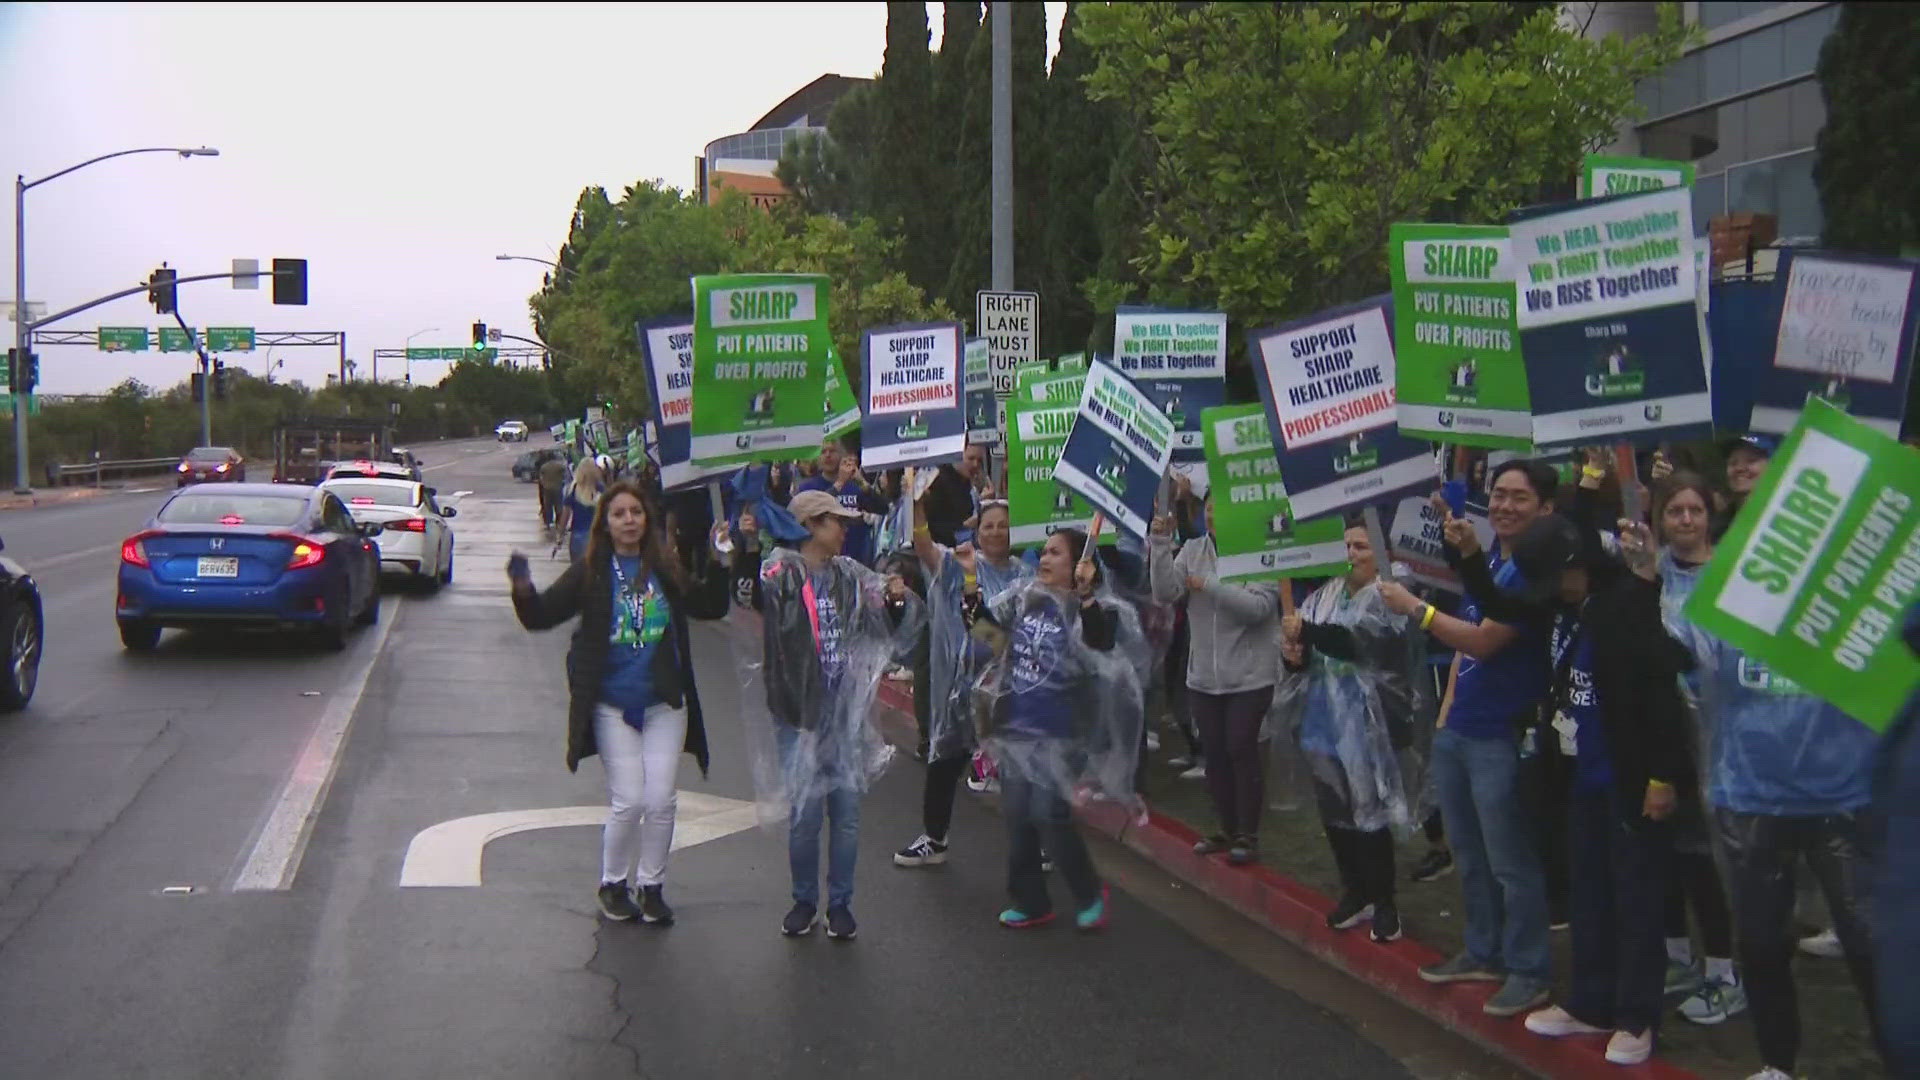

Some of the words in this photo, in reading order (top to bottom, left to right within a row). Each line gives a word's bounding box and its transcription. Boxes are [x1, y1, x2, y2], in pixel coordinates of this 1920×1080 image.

[1535, 234, 1562, 254] We
[1563, 225, 1599, 250] HEAL
[1604, 211, 1678, 241] Together
[1424, 244, 1497, 280] SHARP
[1527, 263, 1554, 284] We
[1556, 251, 1599, 279] FIGHT
[1603, 238, 1679, 267] Together
[1526, 288, 1553, 312] We
[1557, 279, 1594, 306] RISE
[1596, 266, 1679, 300] Together
[730, 291, 798, 320] SHARP
[986, 297, 1032, 311] RIGHT
[1414, 291, 1439, 314] PUT
[1443, 294, 1510, 321] PATIENTS
[987, 317, 1029, 331] LANE
[1131, 324, 1147, 337] We
[1149, 324, 1172, 337] HEAL
[1175, 323, 1219, 337] Together
[1414, 322, 1449, 345] OVER
[1453, 326, 1511, 352] PROFITS
[716, 335, 742, 353] PUT
[746, 334, 809, 353] PATIENTS
[889, 335, 936, 352] SUPPORT
[989, 337, 1029, 351] MUST
[1123, 339, 1140, 354] We
[1142, 339, 1169, 353] FIGHT
[1172, 338, 1218, 354] Together
[1290, 324, 1358, 360] SUPPORT
[715, 363, 750, 380] OVER
[754, 361, 807, 380] PROFITS
[895, 353, 930, 368] SHARP
[1120, 355, 1138, 370] We
[1140, 355, 1165, 369] RISE
[1166, 353, 1217, 370] Together
[1304, 349, 1354, 379] SHARP
[881, 367, 945, 386] HEALTHCARE
[1288, 365, 1383, 406] HEALTHCARE
[872, 384, 953, 409] PROFESSIONALS
[1088, 396, 1104, 416] We
[1104, 408, 1125, 431] RISE
[1126, 423, 1162, 463] Together
[1025, 446, 1046, 461] PUT
[1024, 466, 1053, 482] OVER
[1741, 468, 1842, 596] SHARP
[1792, 593, 1840, 646] PUT
[1823, 487, 1911, 600] PATIENTS
[1832, 606, 1892, 672] OVER
